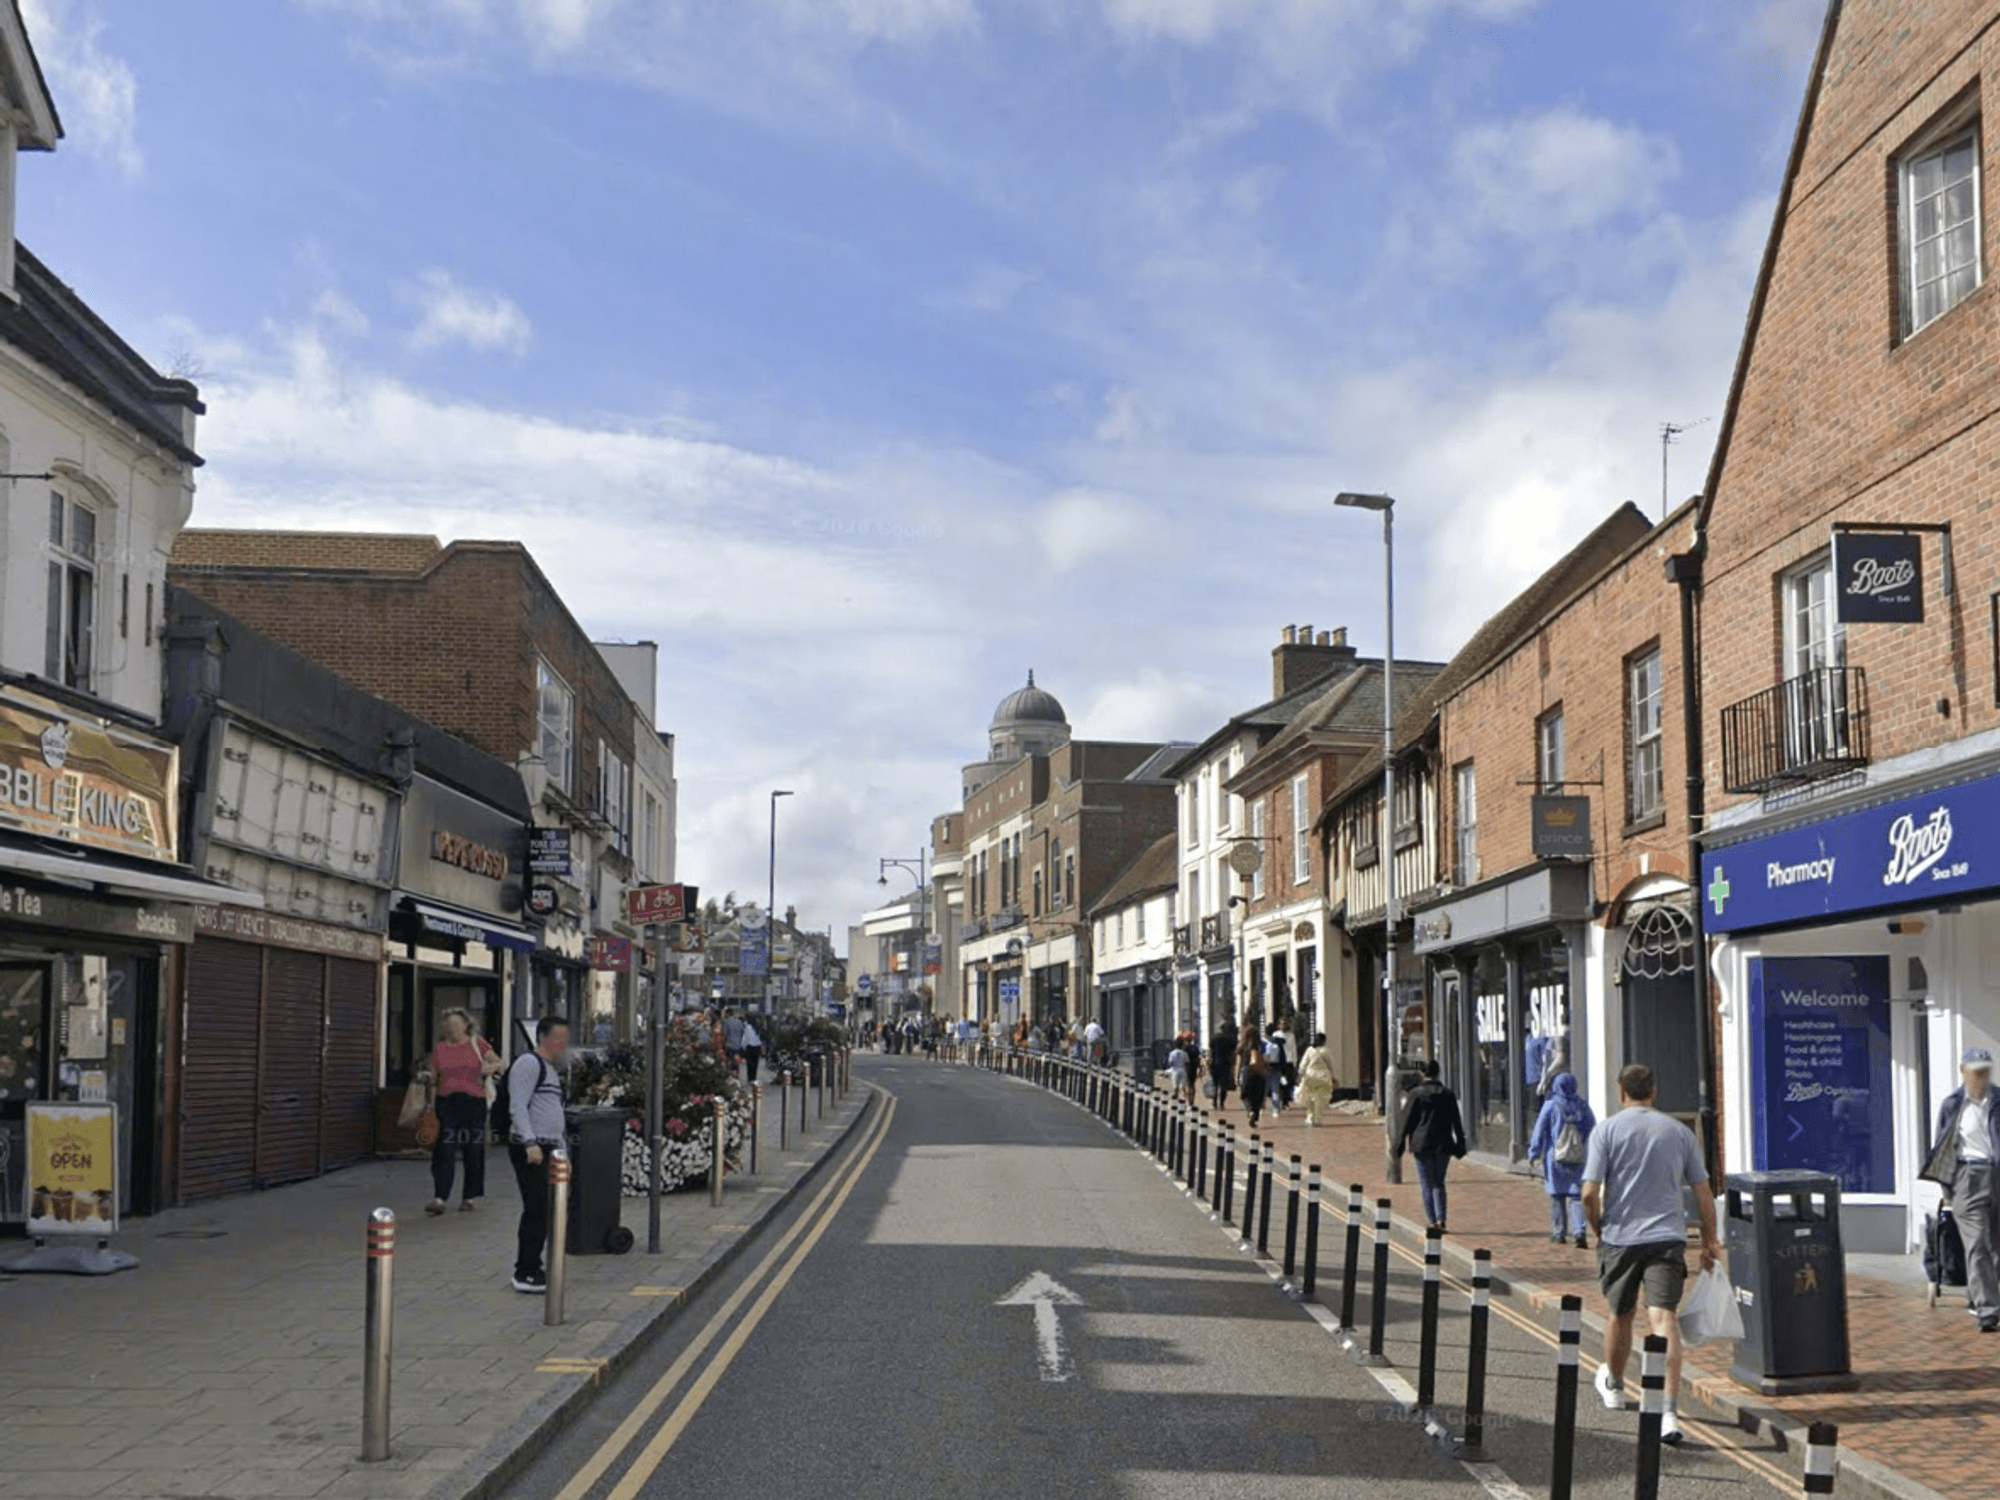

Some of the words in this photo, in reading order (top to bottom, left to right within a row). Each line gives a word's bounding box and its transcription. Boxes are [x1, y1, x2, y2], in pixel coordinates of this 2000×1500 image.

[1847, 557, 1915, 597] Boots
[80, 787, 142, 835] KING
[1883, 805, 1953, 886] Boots
[1767, 857, 1836, 888] Pharmacy
[1933, 866, 1950, 882] Since
[15, 887, 42, 917] Tea
[136, 909, 178, 935] Snacks
[1781, 989, 1869, 1007] Welcome
[1476, 995, 1506, 1043] SALE
[1530, 985, 1565, 1039] SALE
[1784, 1020, 1836, 1030] Healthcare
[1784, 1032, 1842, 1044] Hearingcare
[1784, 1044, 1808, 1055] Food
[1810, 1044, 1817, 1054] &
[1818, 1044, 1843, 1055] drink
[1785, 1057, 1808, 1069] Baby
[1810, 1057, 1818, 1067] &
[1819, 1056, 1843, 1067] child
[1785, 1069, 1813, 1080] Photo
[1784, 1082, 1823, 1102] Boots
[50, 1151, 93, 1170] OPEN
[1776, 1243, 1828, 1259] LITTER
